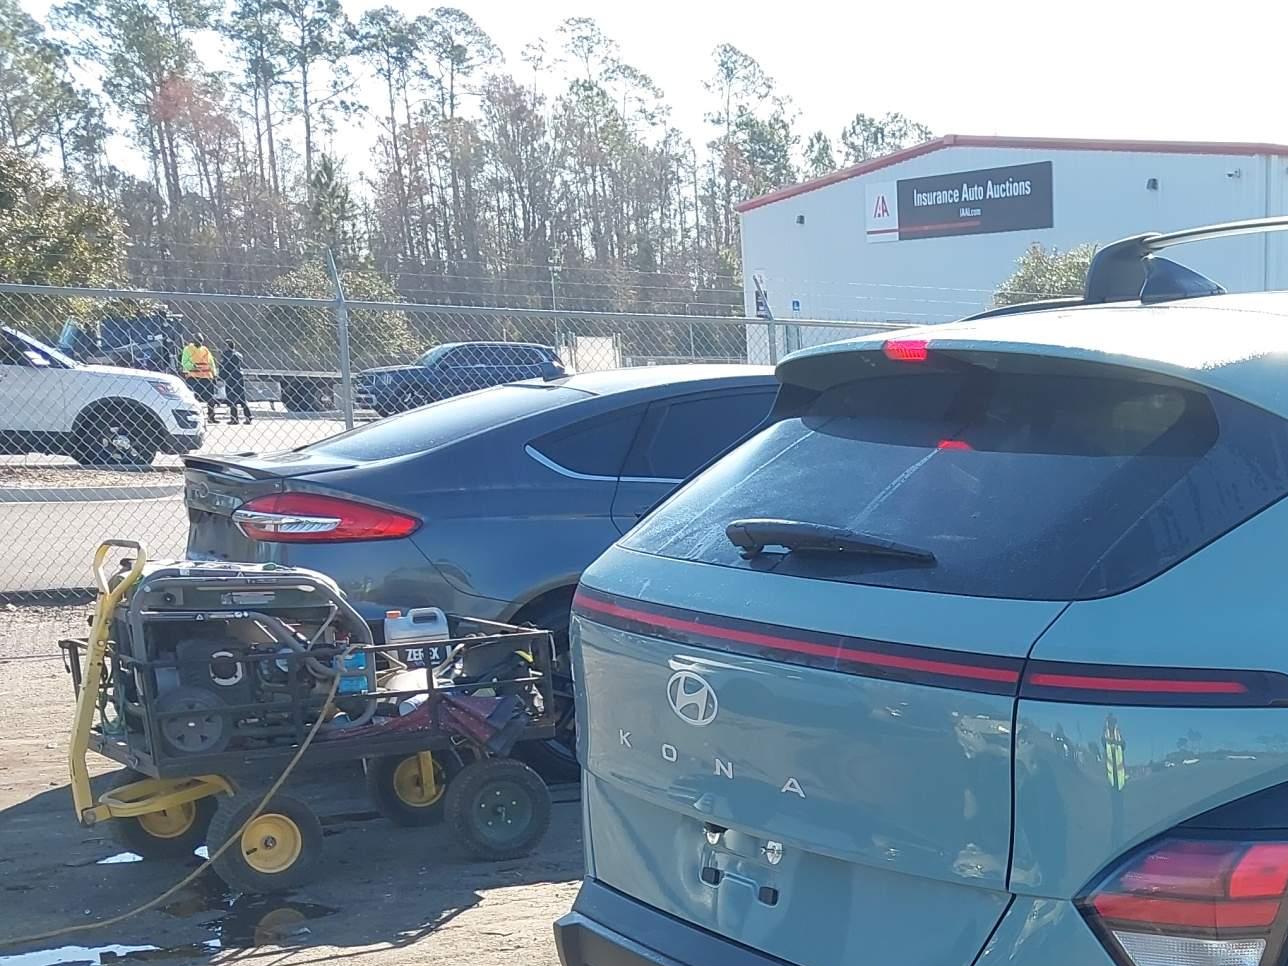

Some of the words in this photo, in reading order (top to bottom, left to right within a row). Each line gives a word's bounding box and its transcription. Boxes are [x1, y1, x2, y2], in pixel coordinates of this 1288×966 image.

[913, 189, 960, 207] Insurance
[961, 183, 984, 202] Auto
[986, 177, 1032, 200] Auctions
[618, 729, 806, 799] KONA
